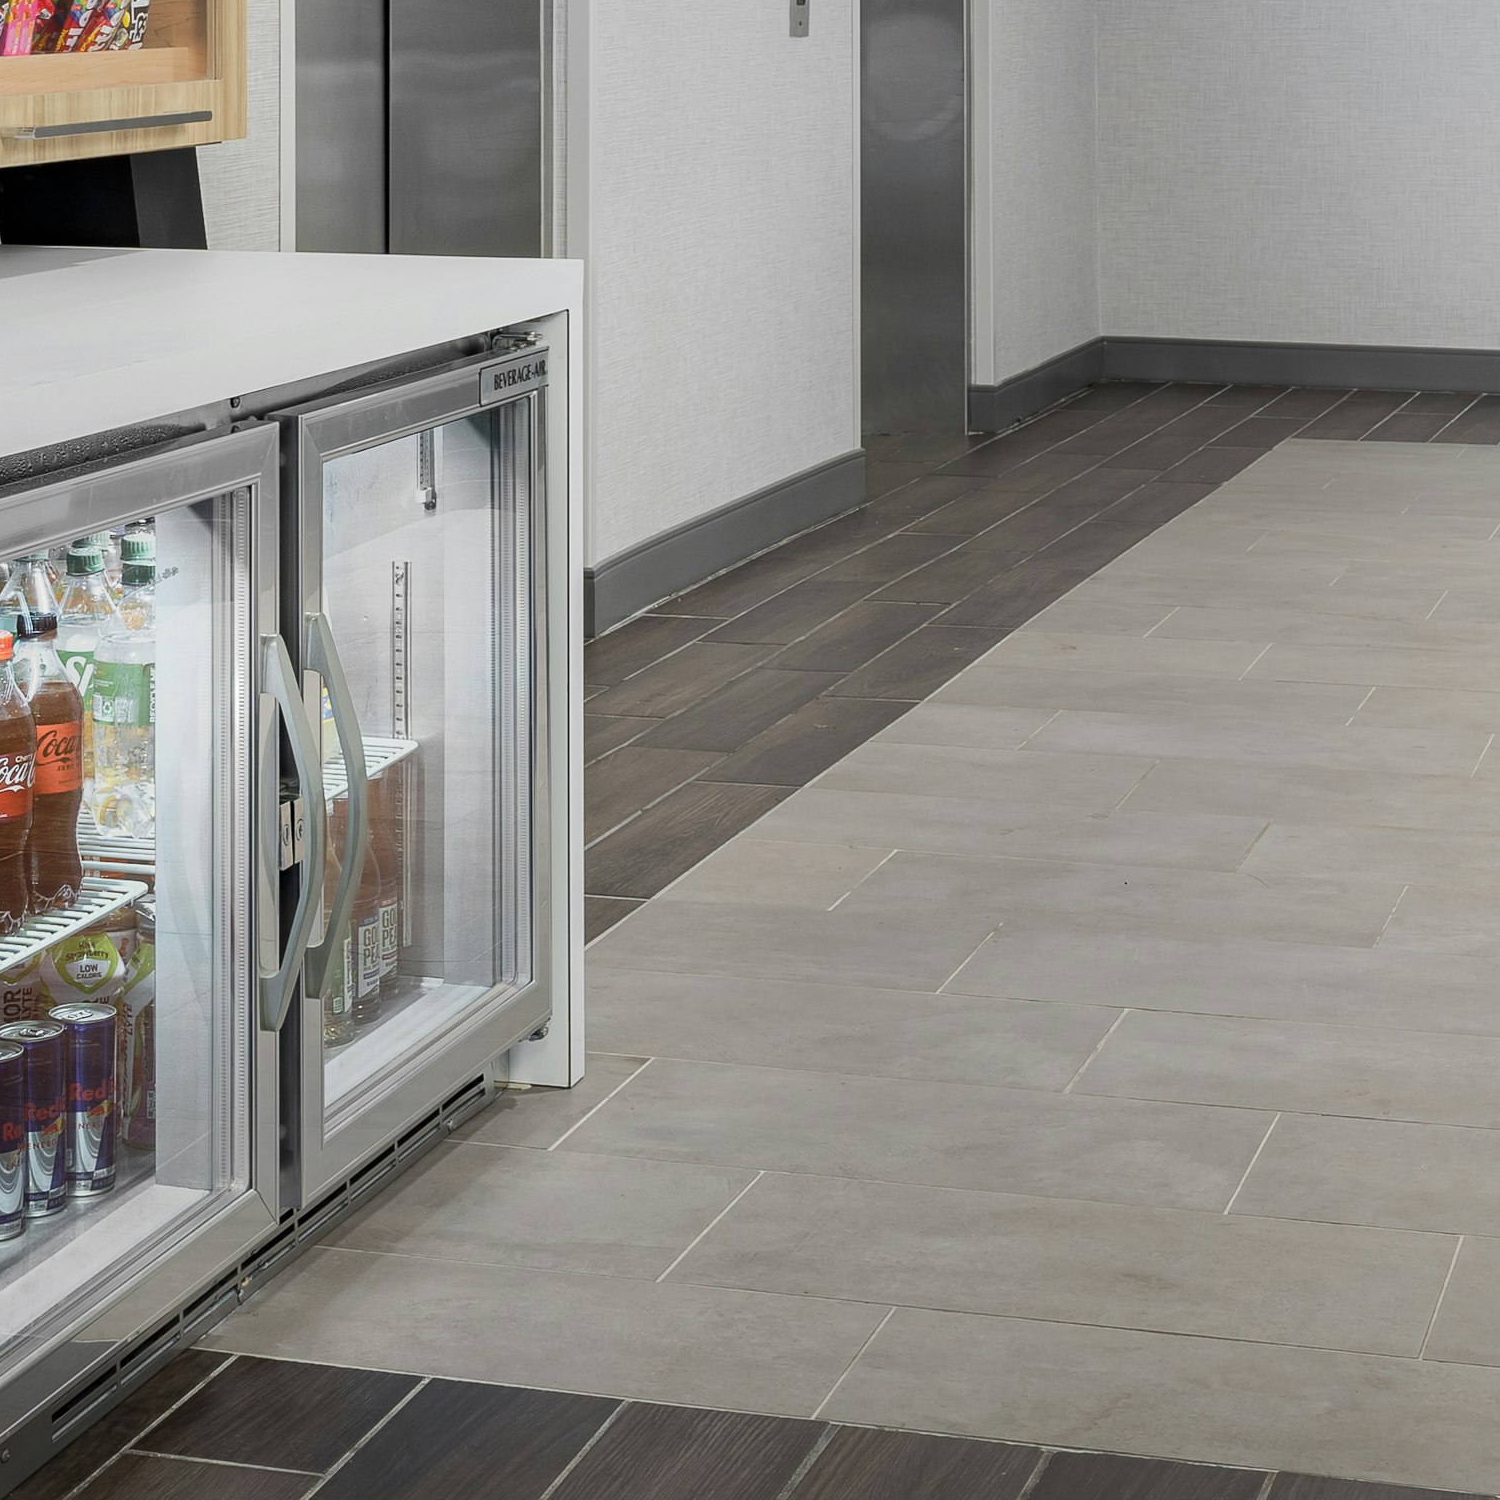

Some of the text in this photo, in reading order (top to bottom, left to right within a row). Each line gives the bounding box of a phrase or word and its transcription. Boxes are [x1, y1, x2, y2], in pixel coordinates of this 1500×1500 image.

[76, 971, 102, 980] CALORIE
[79, 964, 98, 973] LOW
[68, 1082, 108, 1102] Red
[23, 1102, 59, 1122] Red
